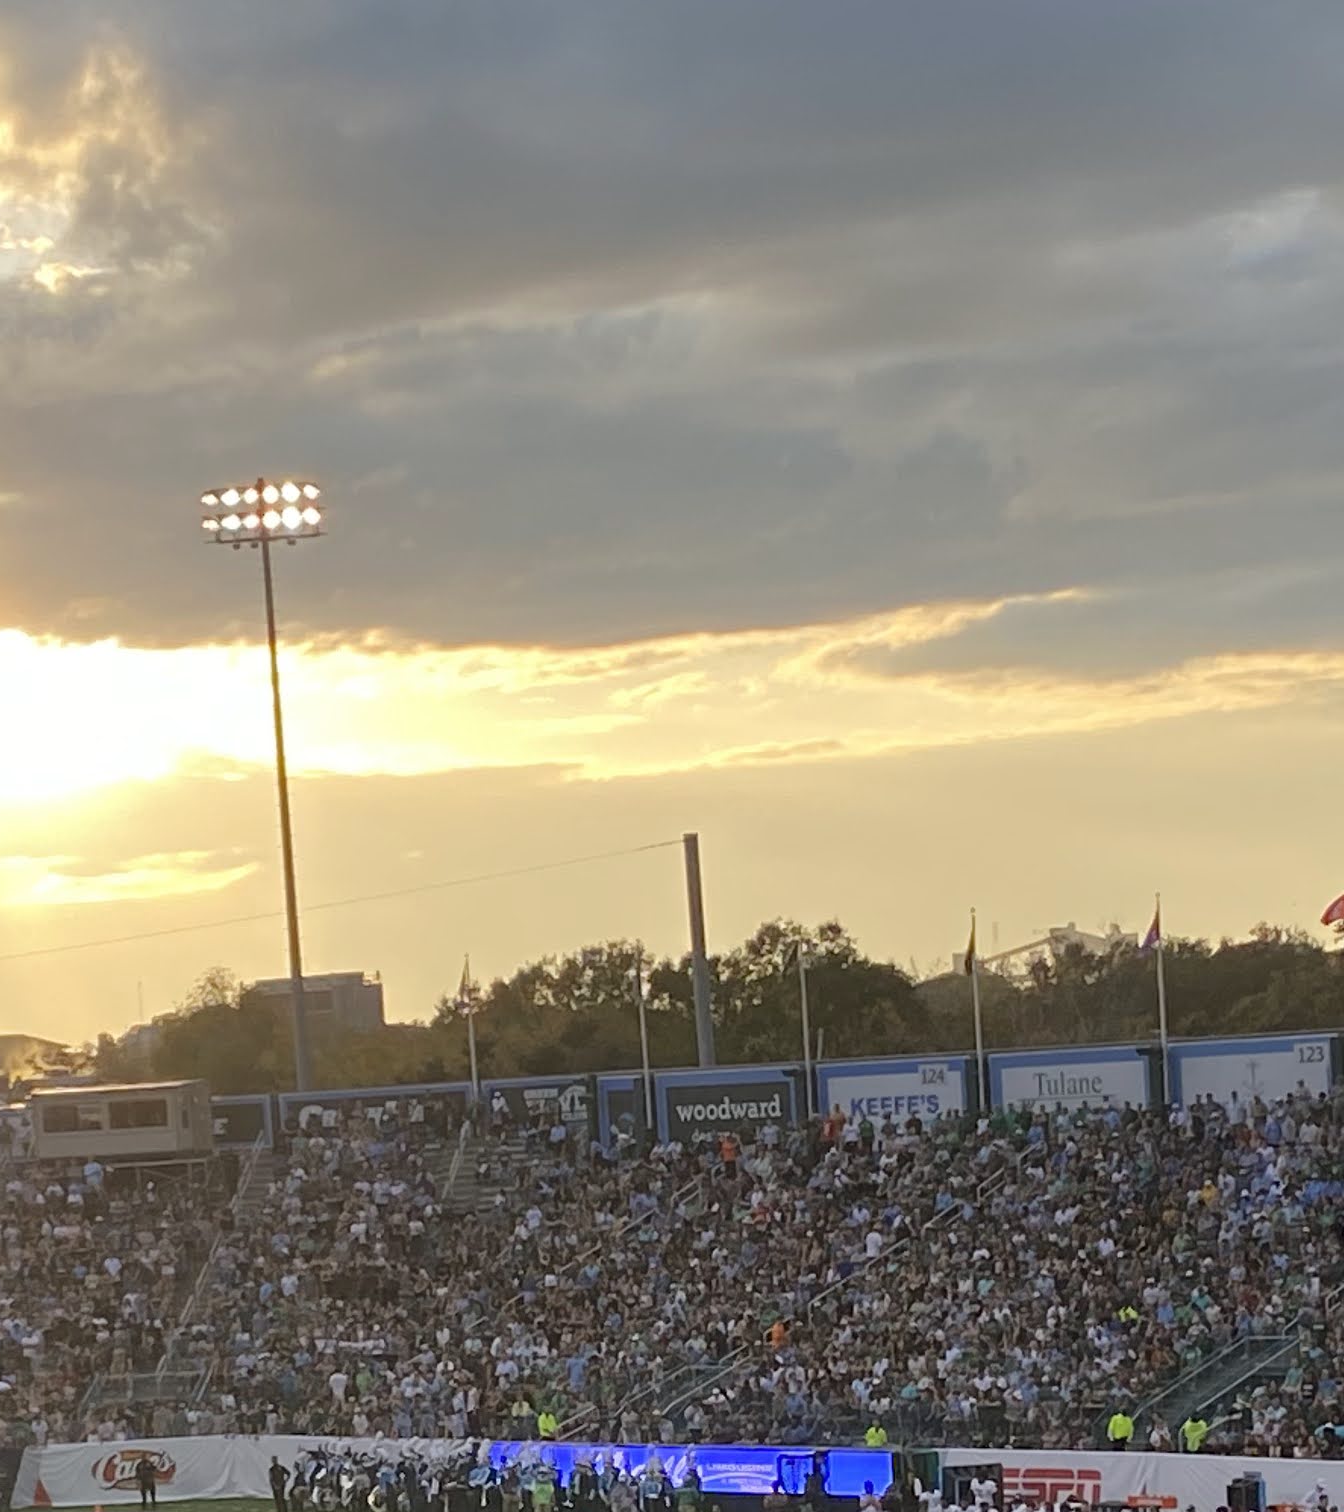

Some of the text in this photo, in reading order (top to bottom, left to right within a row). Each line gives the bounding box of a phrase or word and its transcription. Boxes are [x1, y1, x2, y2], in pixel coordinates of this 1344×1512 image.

[1298, 1047, 1325, 1064] 123
[921, 1068, 945, 1085] 124
[1033, 1071, 1103, 1097] Tulane
[676, 1094, 782, 1122] woodward
[850, 1095, 940, 1117] KEEFE'S
[1002, 1468, 1101, 1504] ESPN
